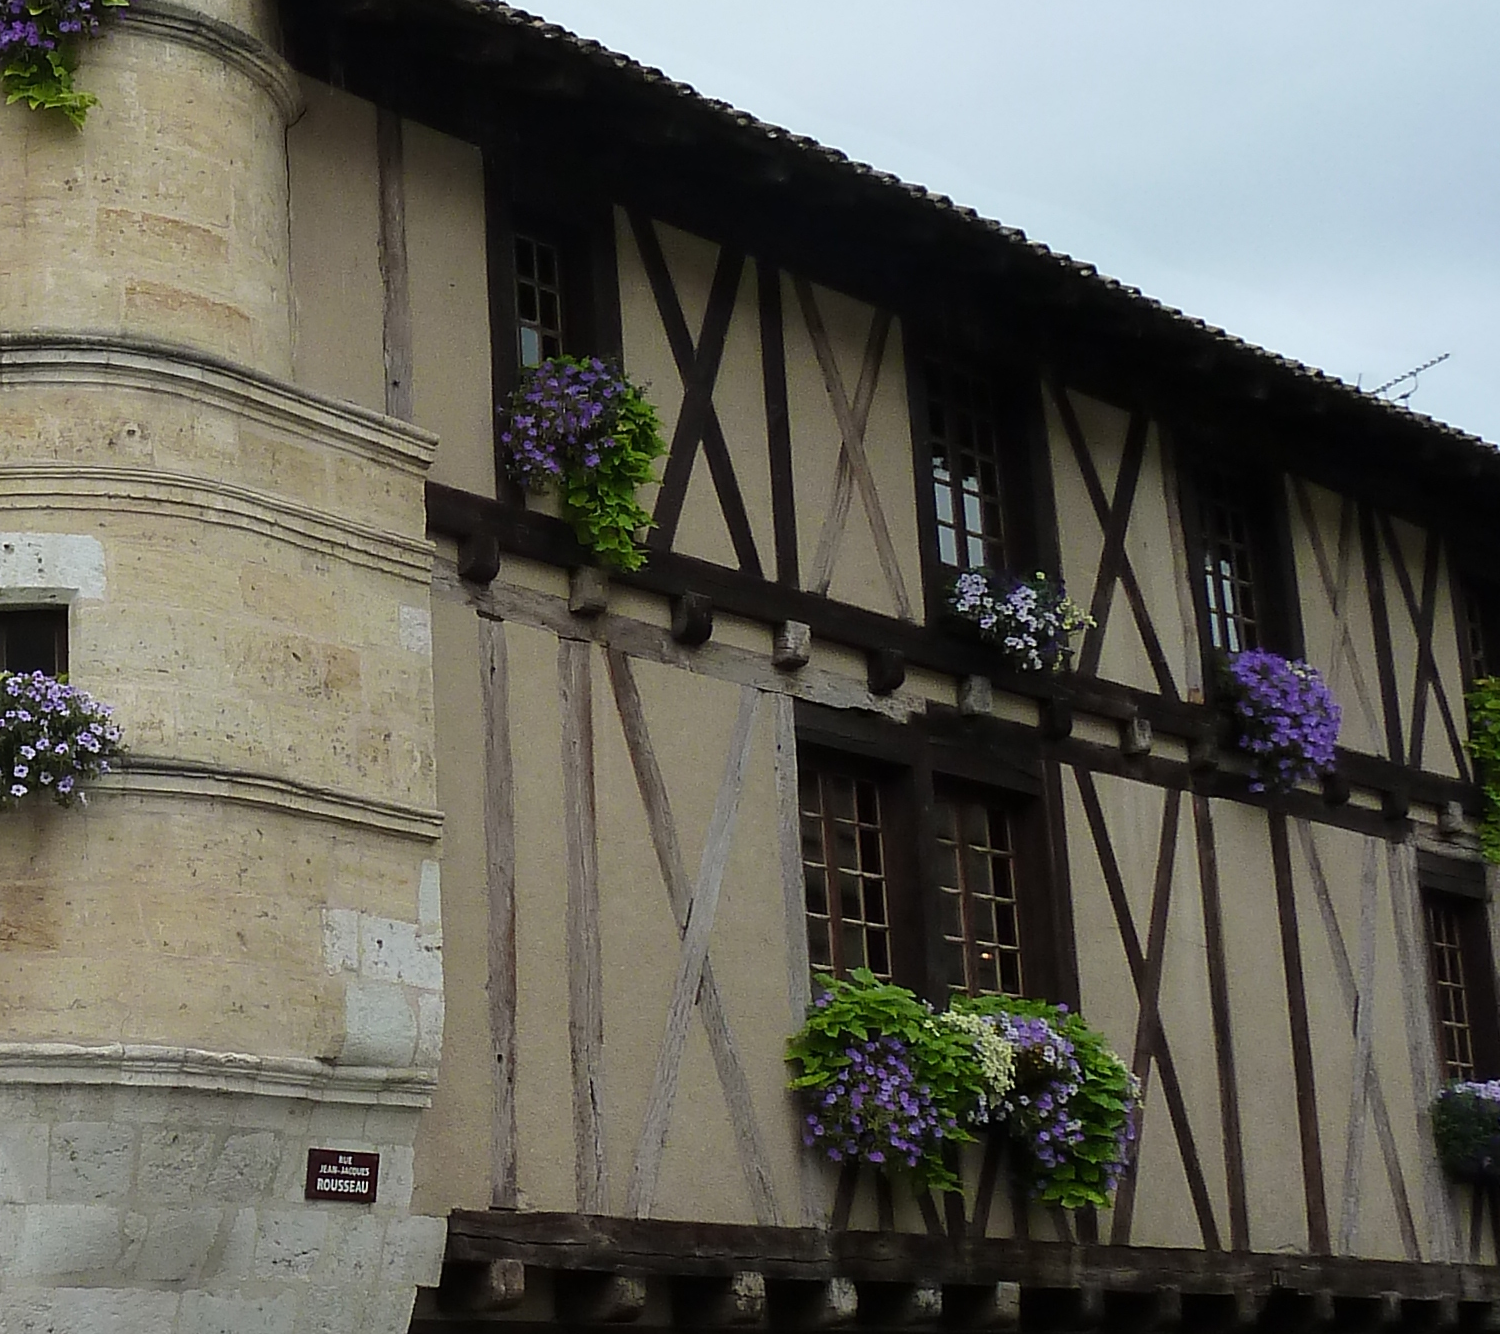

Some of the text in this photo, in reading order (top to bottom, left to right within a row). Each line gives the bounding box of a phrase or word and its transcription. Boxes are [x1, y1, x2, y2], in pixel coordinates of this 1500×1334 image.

[338, 1155, 353, 1165] RUE
[319, 1164, 370, 1177] JEAN-JACQUES
[316, 1178, 369, 1194] ROUSSEAU
